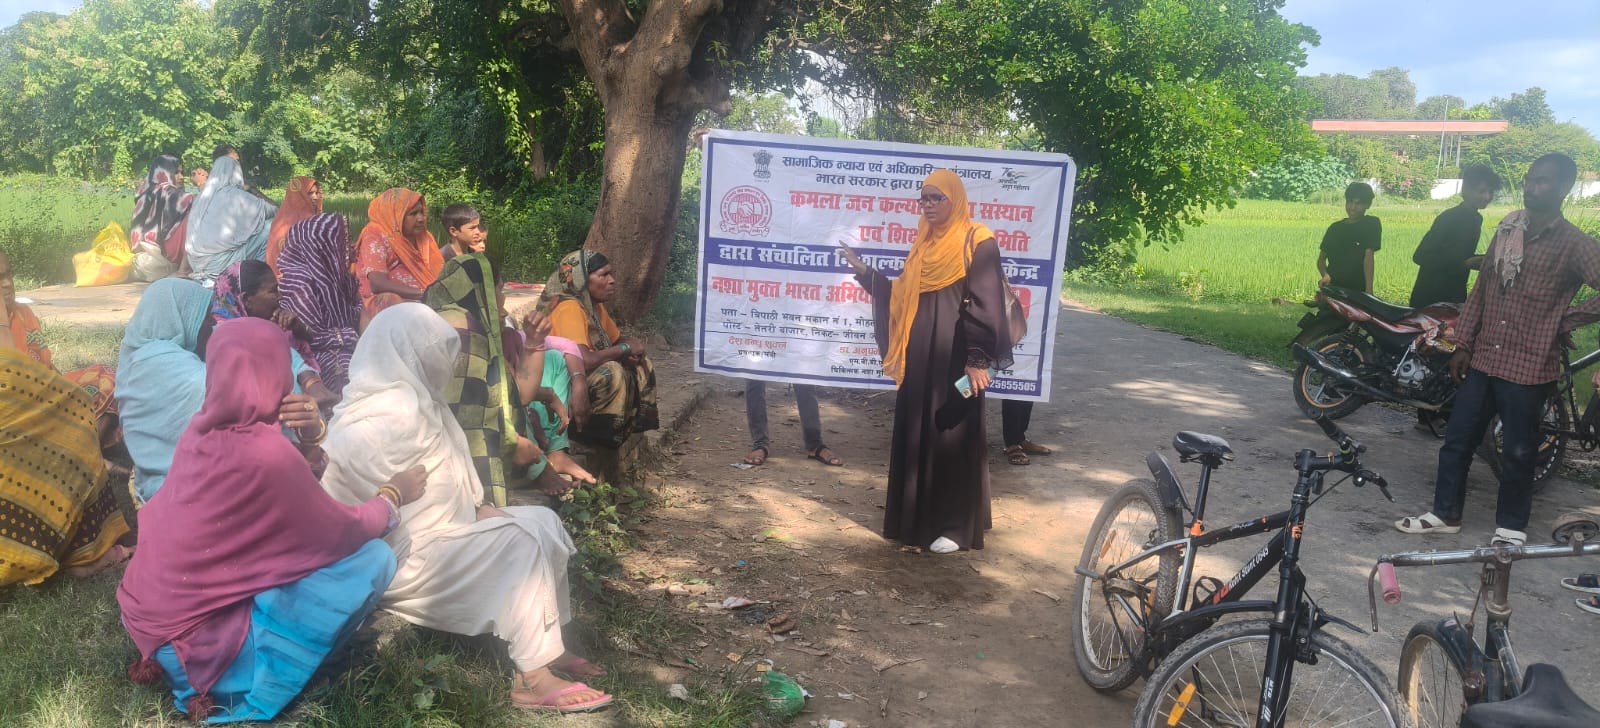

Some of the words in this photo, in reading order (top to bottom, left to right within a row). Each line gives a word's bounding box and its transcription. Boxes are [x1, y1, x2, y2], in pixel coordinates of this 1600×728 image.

[782, 156, 833, 168] सामाजिक
[836, 160, 865, 171] न्याय
[868, 161, 882, 173] एवं
[815, 173, 846, 184] भारत
[848, 176, 888, 188] सरकार
[890, 179, 913, 190] द्वारा
[789, 190, 842, 210] कमला
[845, 194, 876, 212] जन
[879, 196, 922, 215] कल्या
[980, 198, 1035, 222] संस्थान
[859, 221, 885, 242] एवं
[992, 229, 1031, 251] मिति
[718, 244, 753, 260] द्वारा
[758, 245, 830, 267] संचालित
[711, 276, 743, 295] नशा
[746, 279, 781, 302] मुक्त
[785, 282, 822, 301] भारत
[825, 281, 873, 304] अभिया
[987, 379, 1037, 393] 25955505
